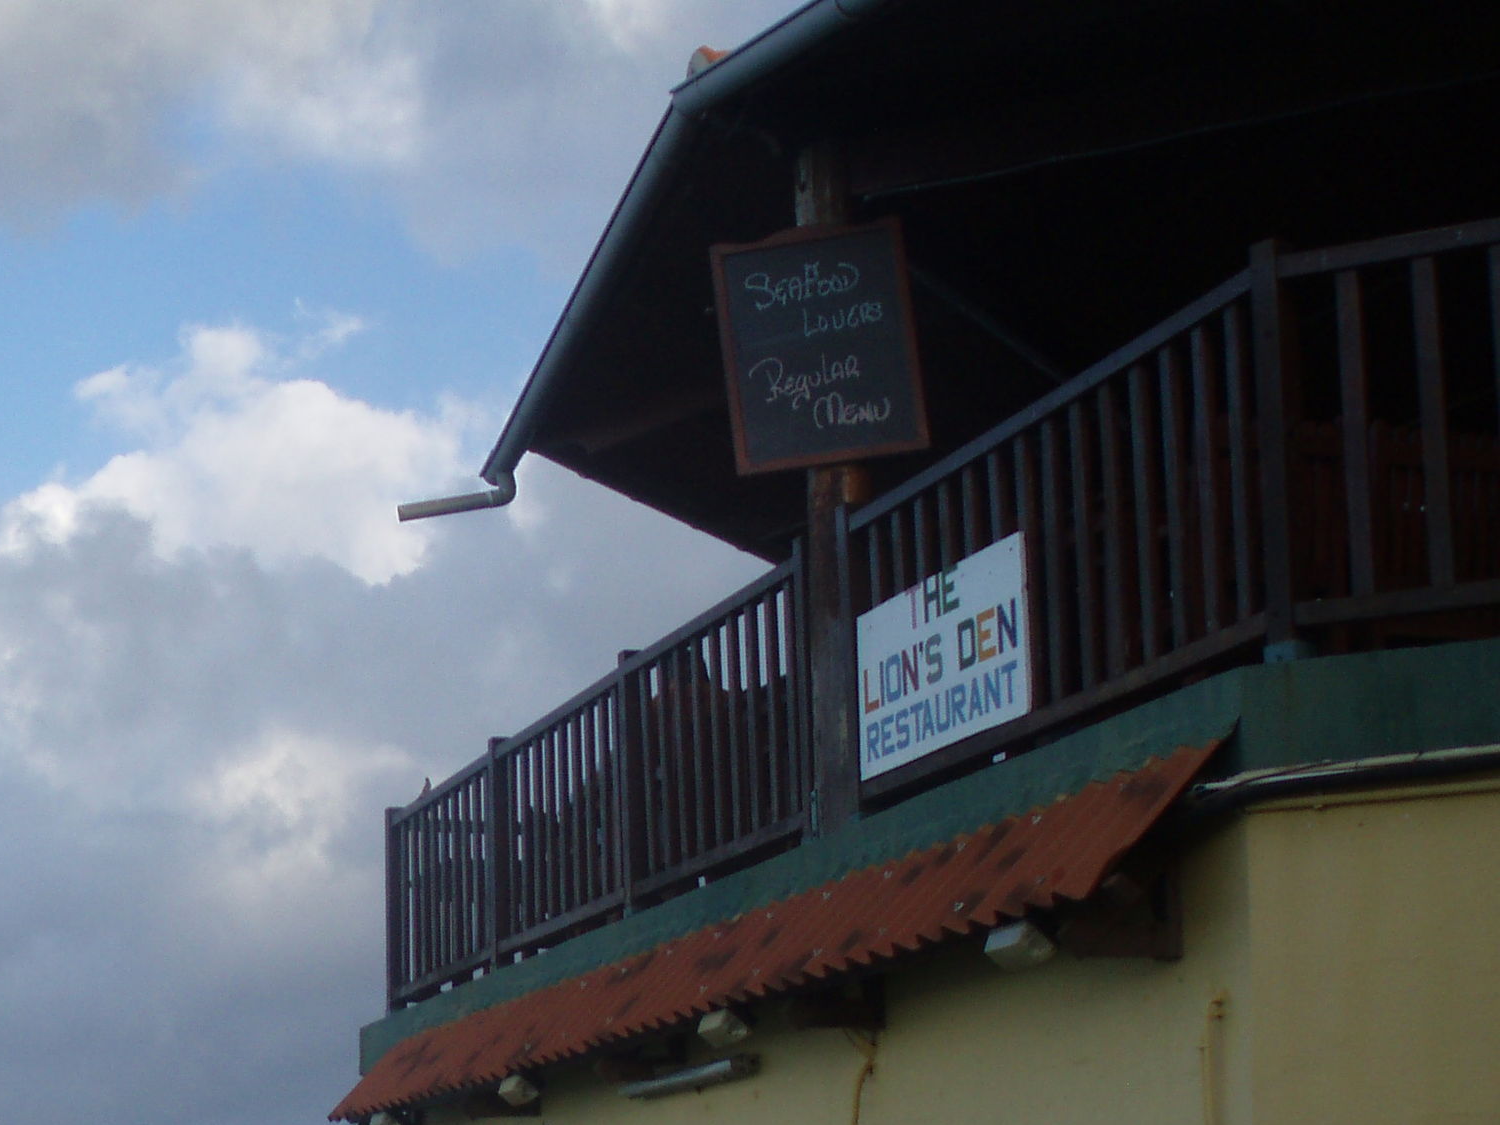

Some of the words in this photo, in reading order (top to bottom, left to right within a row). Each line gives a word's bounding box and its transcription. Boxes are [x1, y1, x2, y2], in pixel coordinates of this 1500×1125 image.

[904, 563, 960, 630] THE
[863, 634, 944, 714] LION'S
[957, 598, 1018, 671] DEN
[866, 659, 1018, 763] RESTAURANT
